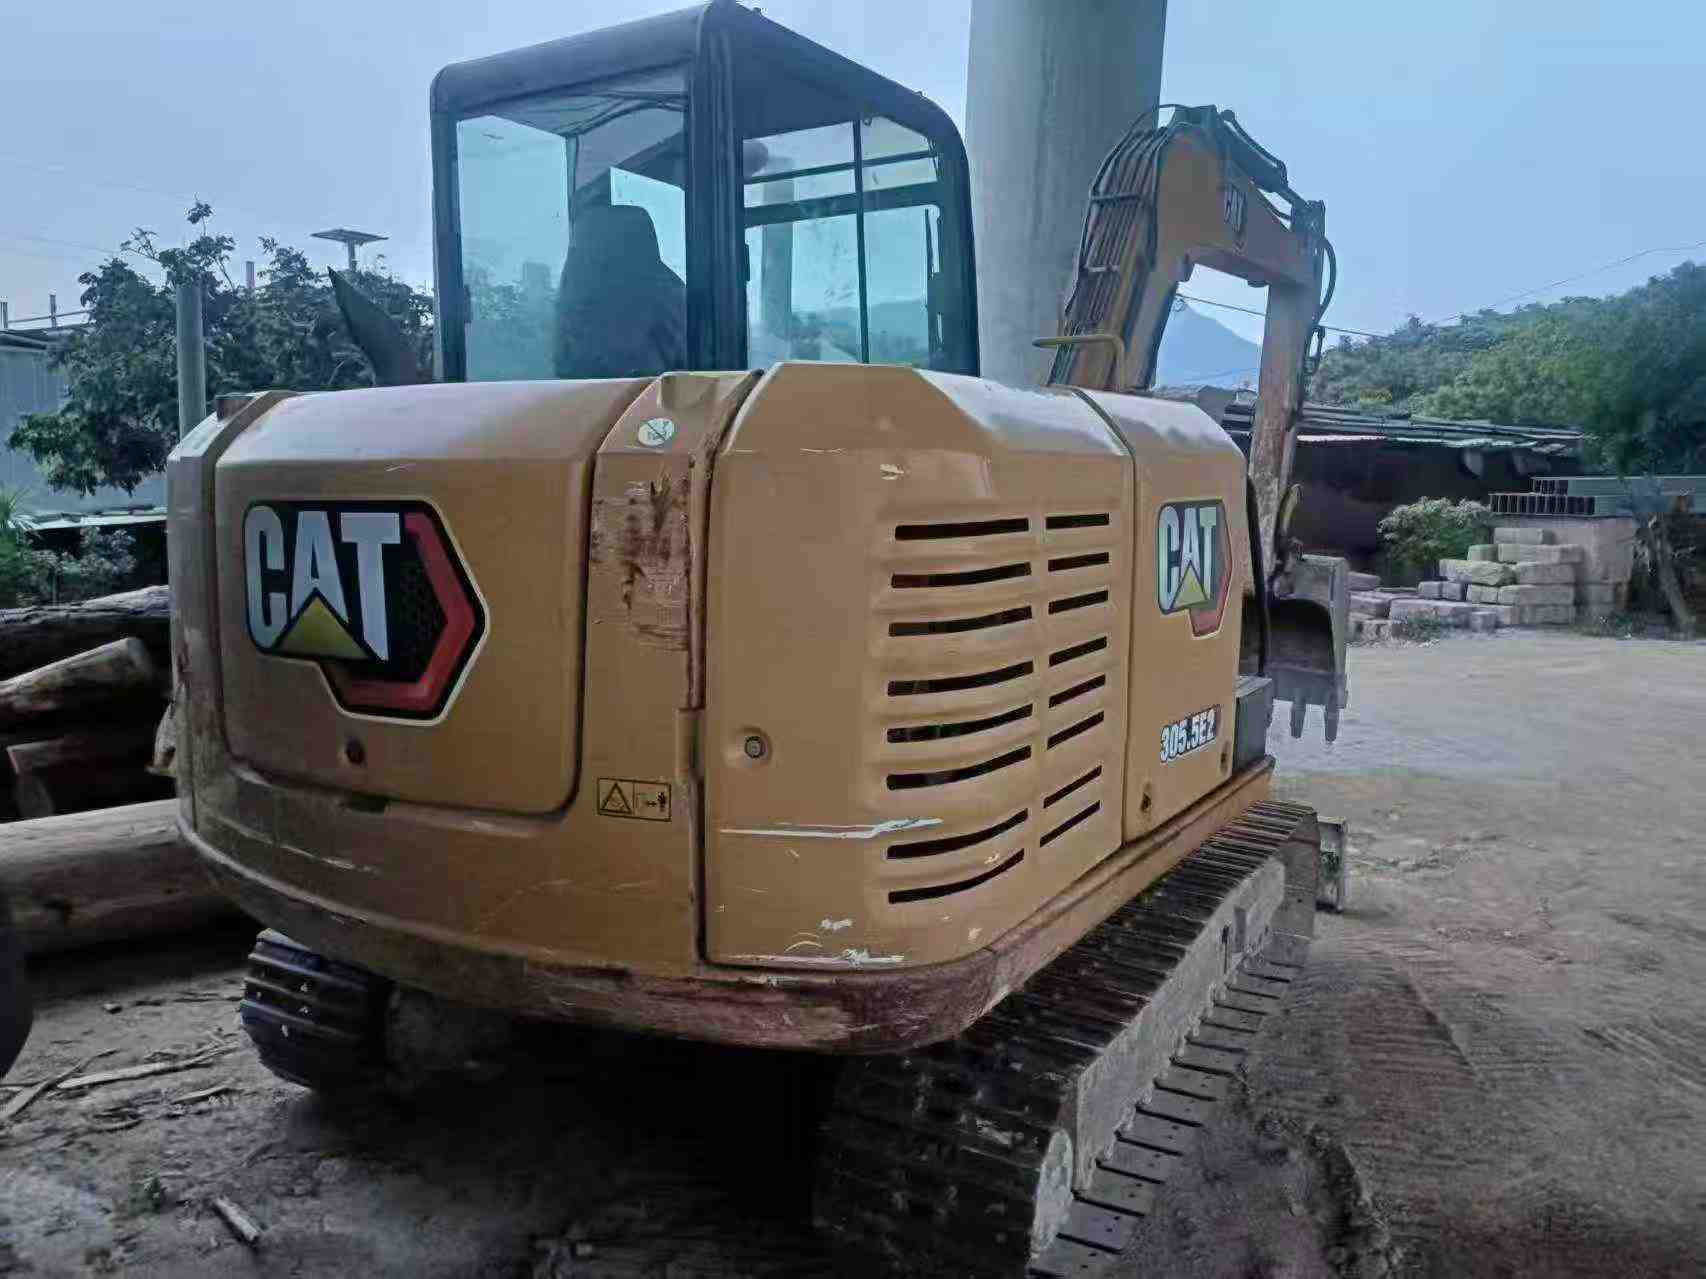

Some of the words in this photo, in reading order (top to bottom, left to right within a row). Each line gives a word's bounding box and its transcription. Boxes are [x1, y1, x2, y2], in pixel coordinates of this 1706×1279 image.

[244, 505, 401, 662] CAT
[1158, 505, 1217, 610] CAT
[1160, 708, 1216, 761] 305.5E2
